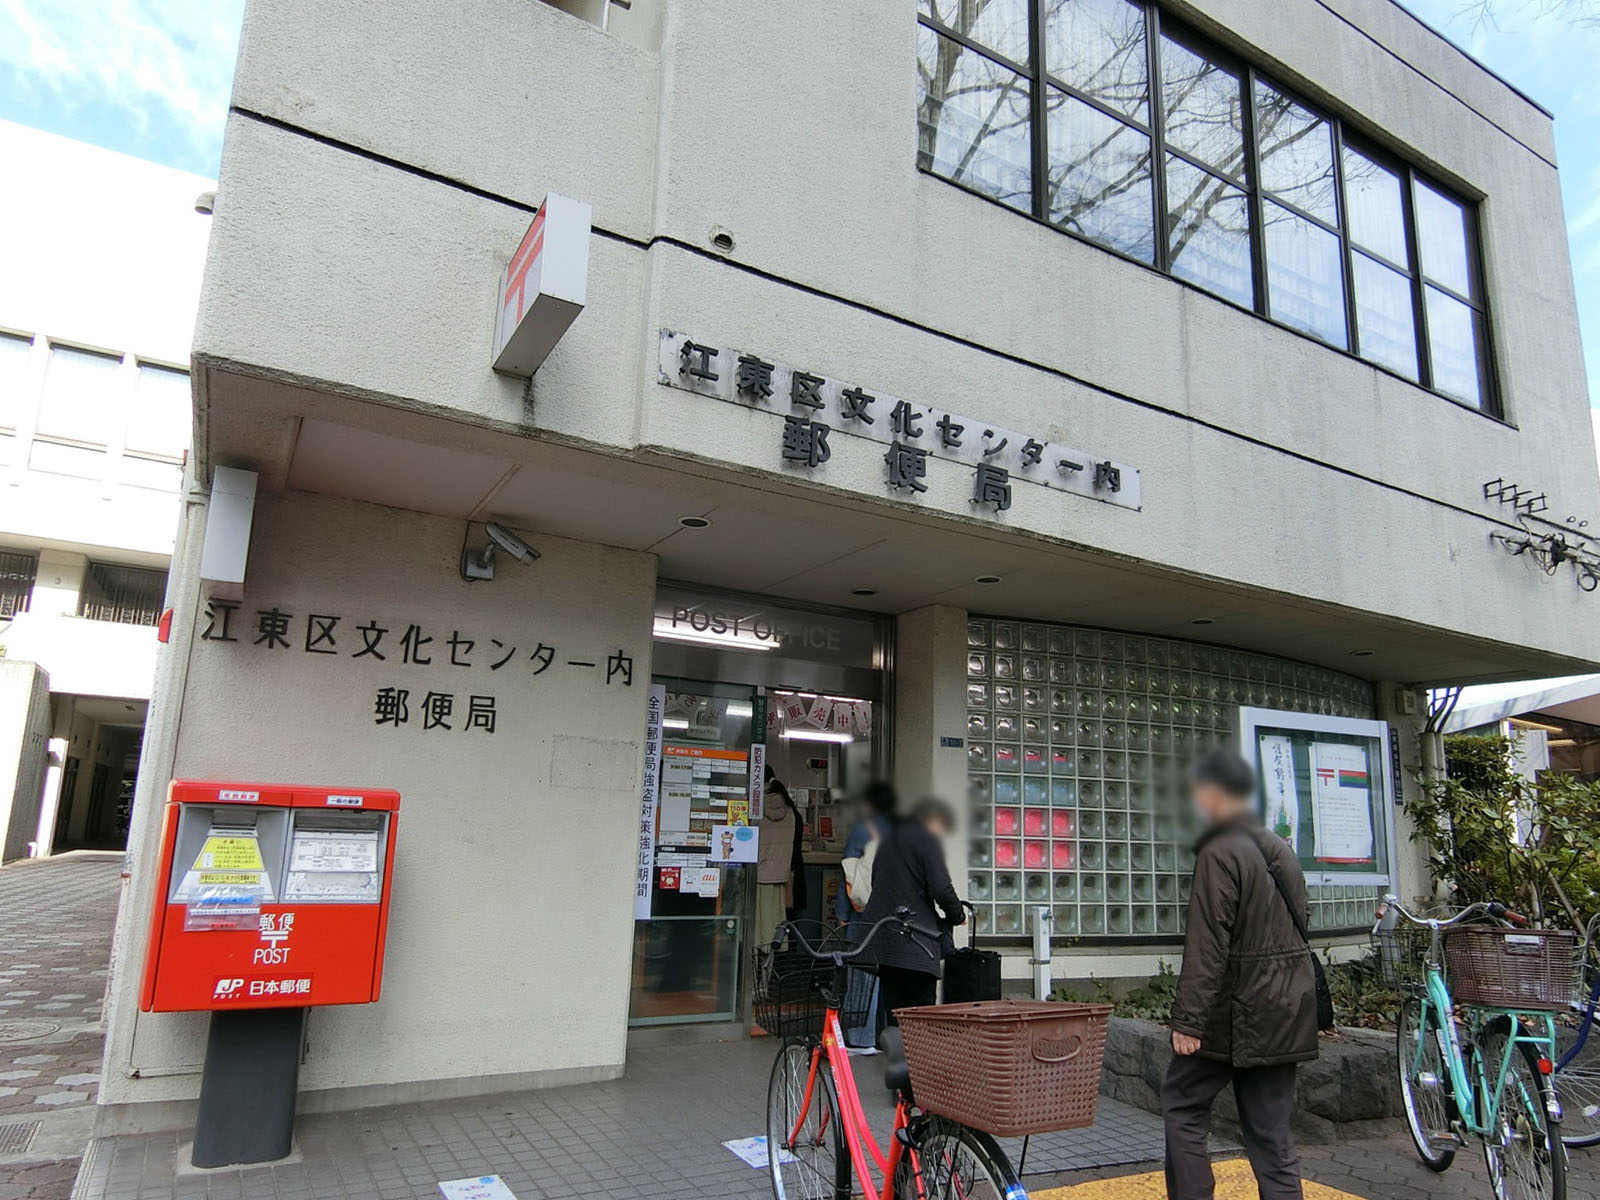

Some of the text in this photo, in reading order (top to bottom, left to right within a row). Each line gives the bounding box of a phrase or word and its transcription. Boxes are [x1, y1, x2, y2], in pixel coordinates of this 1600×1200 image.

[679, 340, 1121, 493] 江東区文化センター内
[782, 415, 1012, 512] 郵便局
[201, 600, 634, 687] 江東区文化センター内
[672, 606, 745, 637] POST
[374, 687, 497, 733] 郵便局
[637, 695, 660, 898] 全国郵便局強盗対策強化期間
[258, 912, 296, 932] 郵便
[253, 947, 291, 965] POST
[249, 978, 312, 996] 日本郵便
